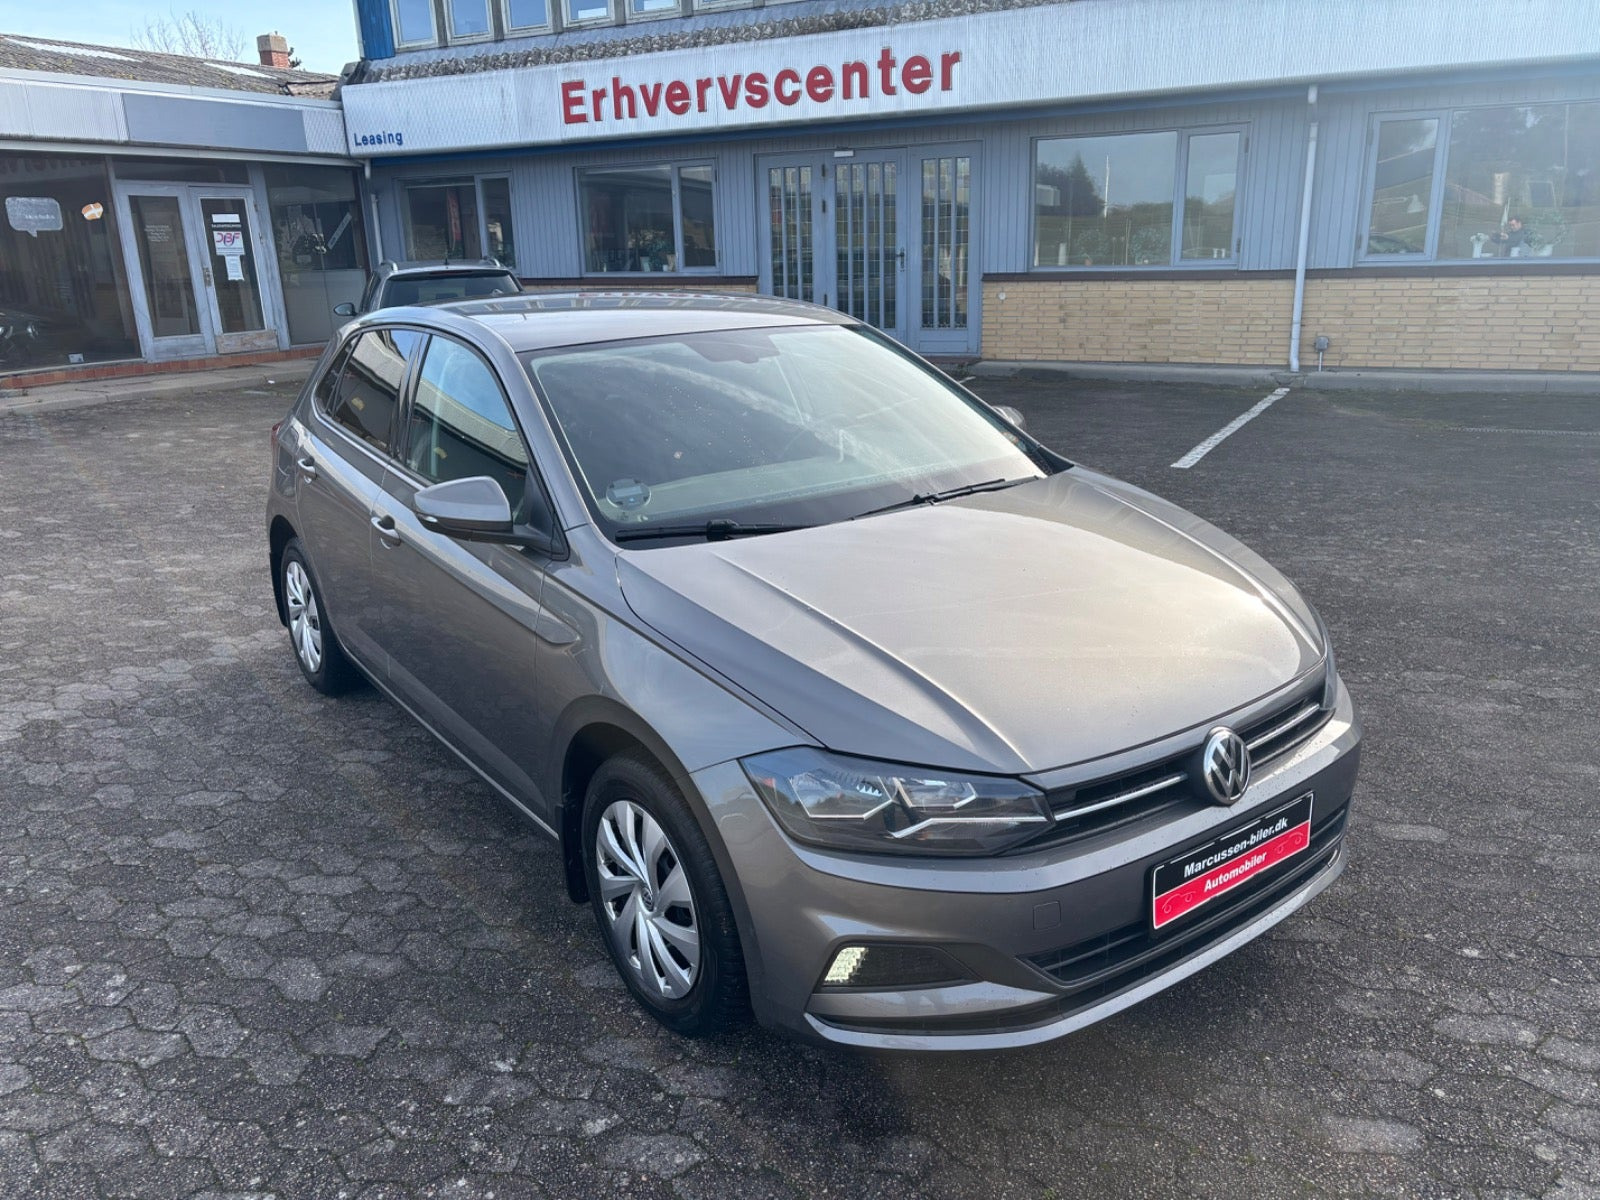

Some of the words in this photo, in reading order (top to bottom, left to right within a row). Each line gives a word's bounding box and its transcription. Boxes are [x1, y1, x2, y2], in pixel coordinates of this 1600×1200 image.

[560, 46, 962, 125] Erhvervscenter
[353, 130, 404, 147] Leasing
[1183, 817, 1289, 878] Marcussen-biler.dk
[1204, 851, 1268, 893] Automobiler
